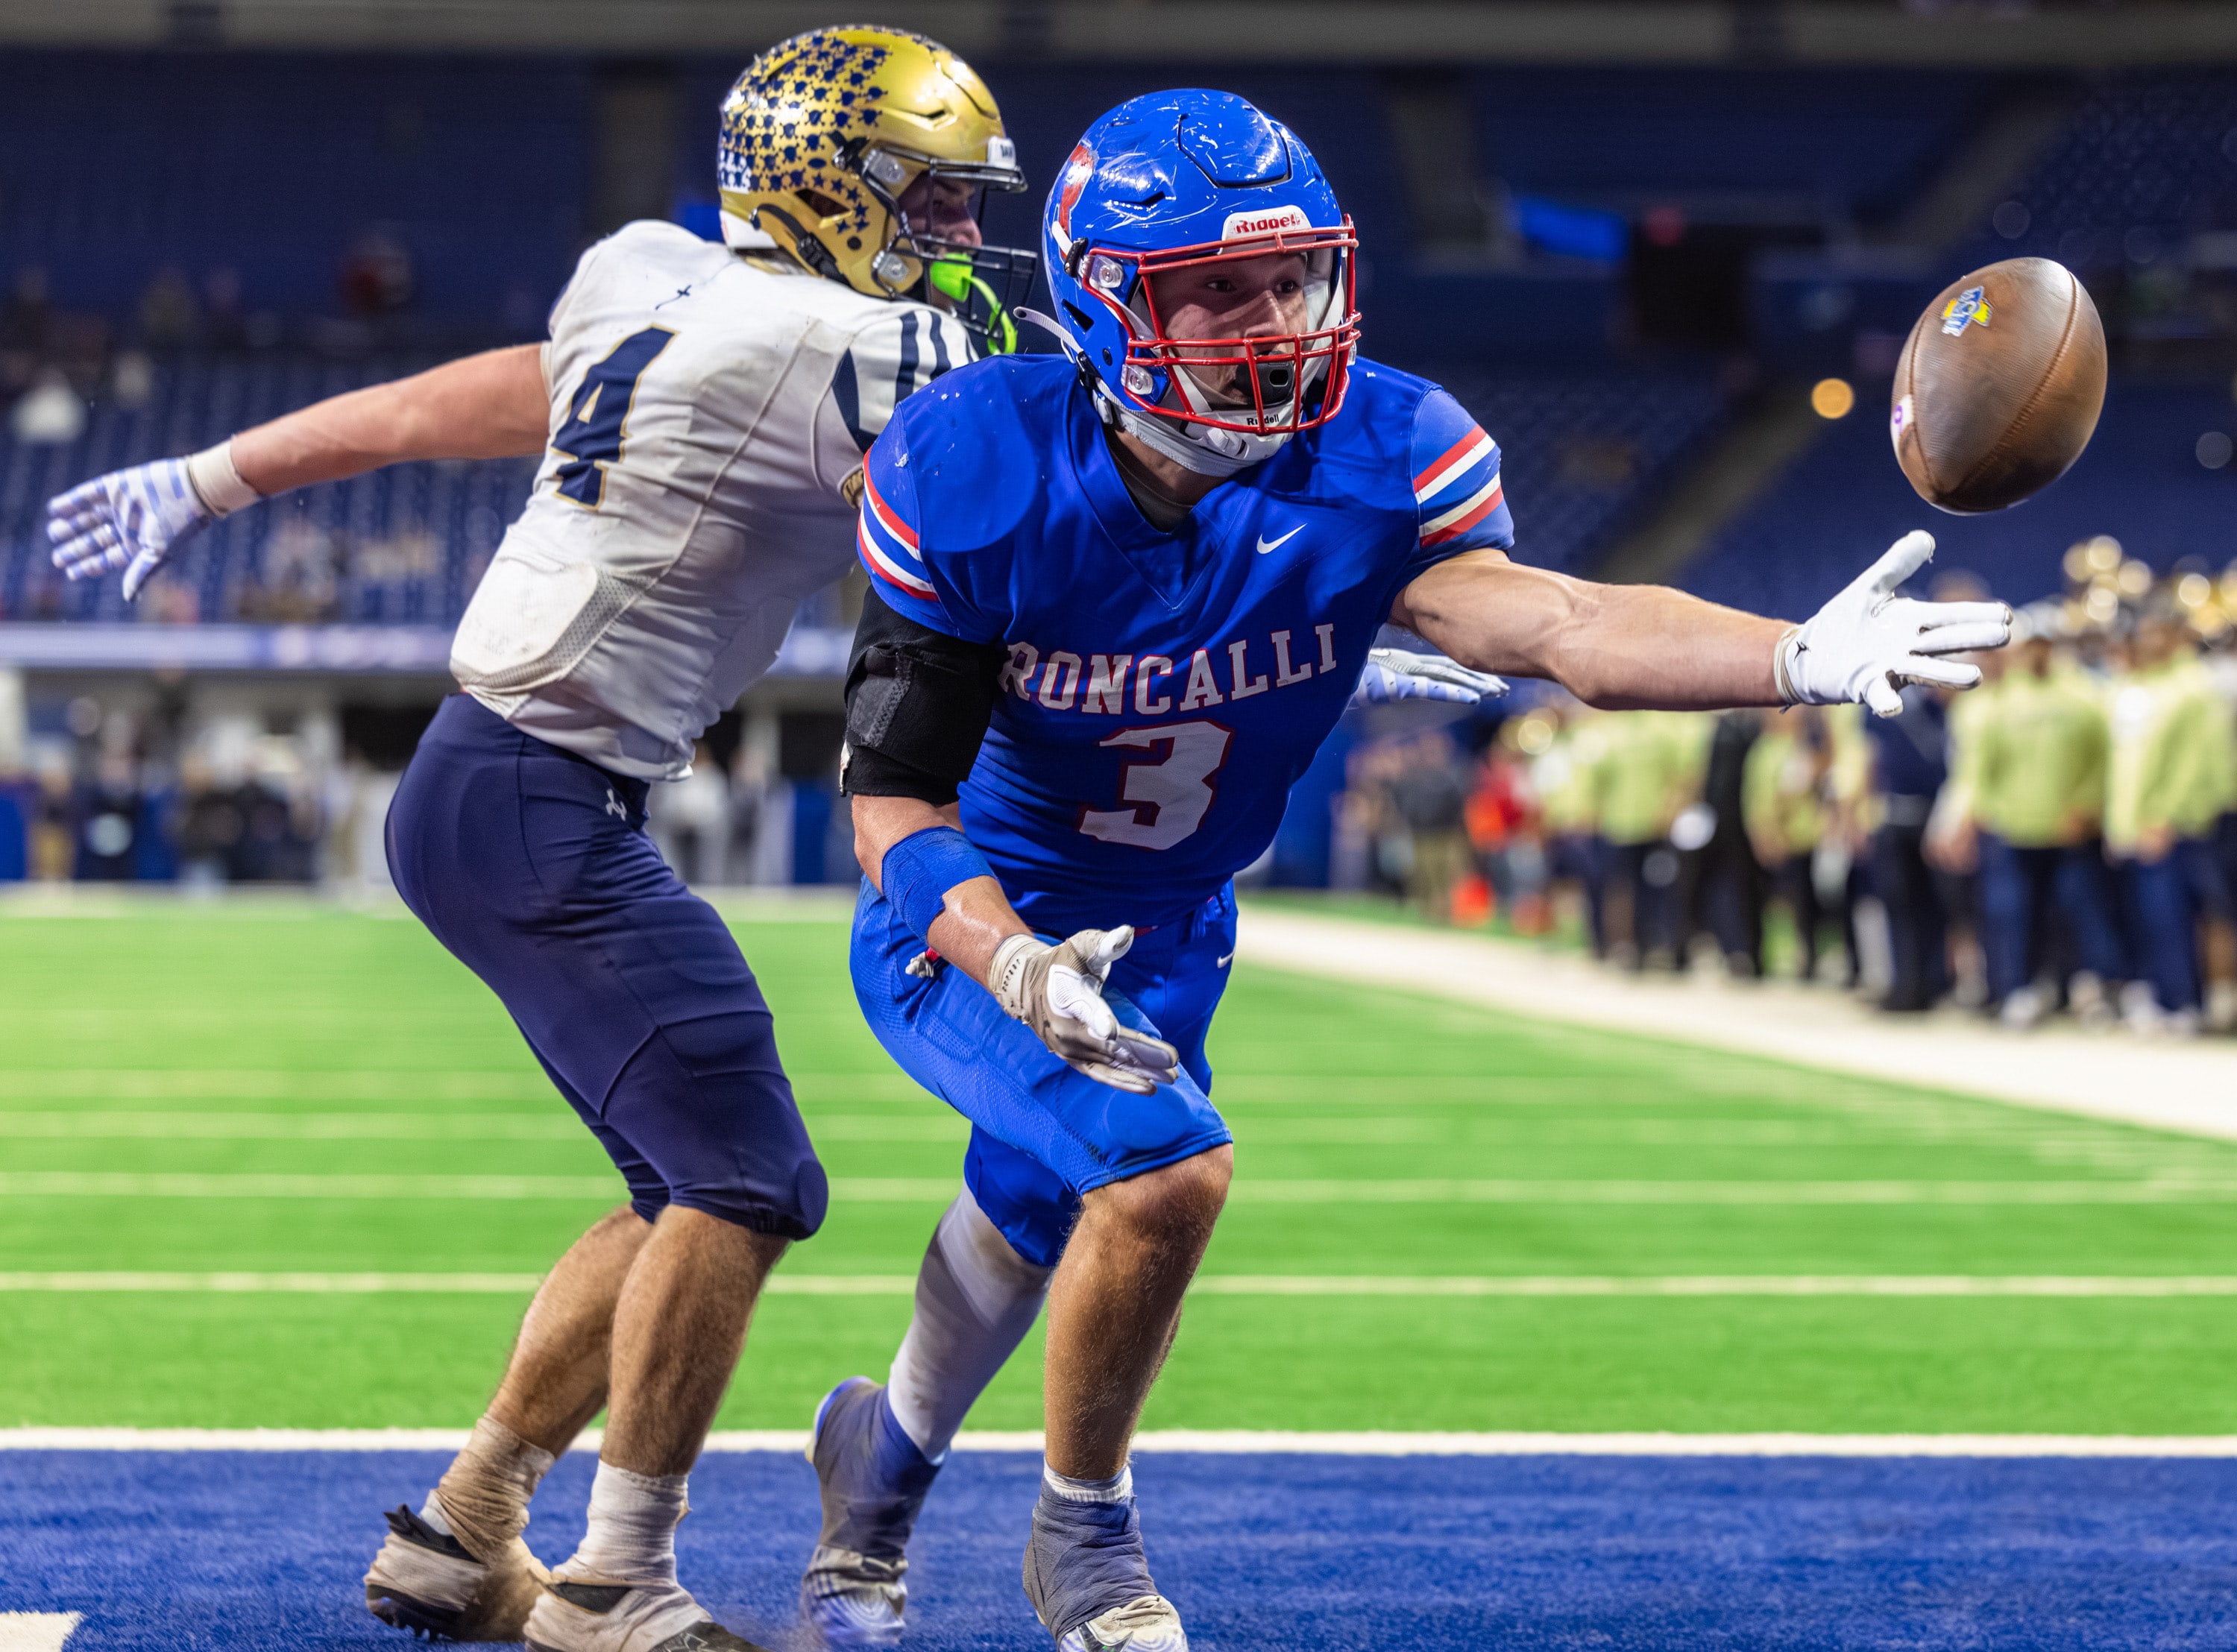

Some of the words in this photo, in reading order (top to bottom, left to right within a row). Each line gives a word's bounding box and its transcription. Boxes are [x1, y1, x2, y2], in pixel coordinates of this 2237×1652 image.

[551, 323, 681, 514] 4
[1246, 414, 1280, 426] Ridell
[996, 622, 1337, 716] RONCALLI
[1077, 718, 1234, 851] 3
